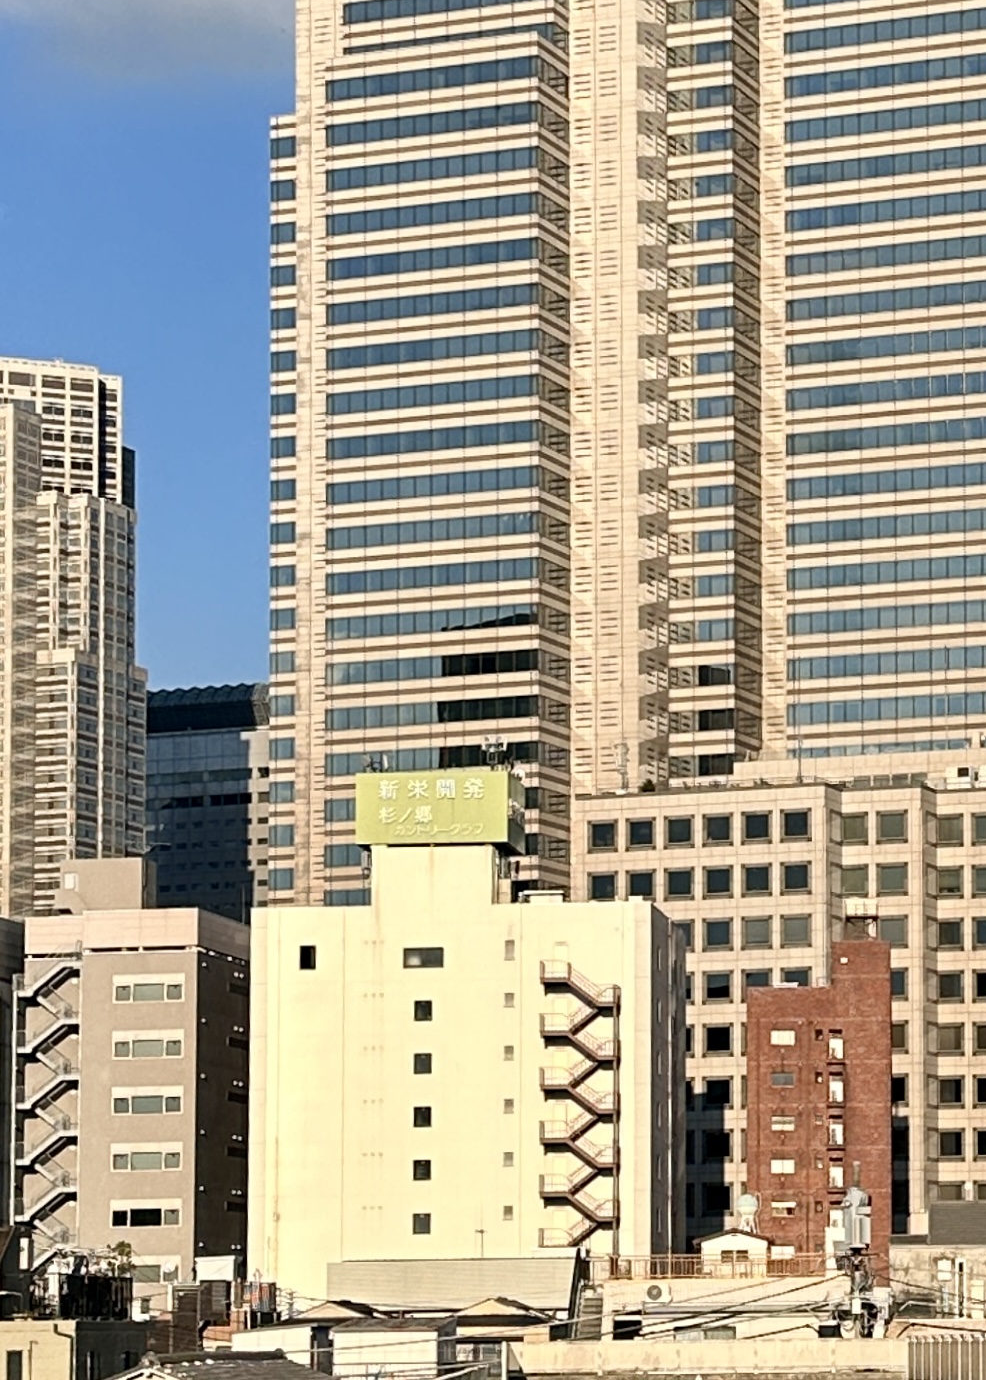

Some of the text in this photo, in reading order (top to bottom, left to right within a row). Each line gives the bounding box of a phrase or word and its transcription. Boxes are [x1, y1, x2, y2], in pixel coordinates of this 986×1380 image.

[378, 777, 485, 800] 新栄開発
[378, 805, 433, 824] 杉ノ郷
